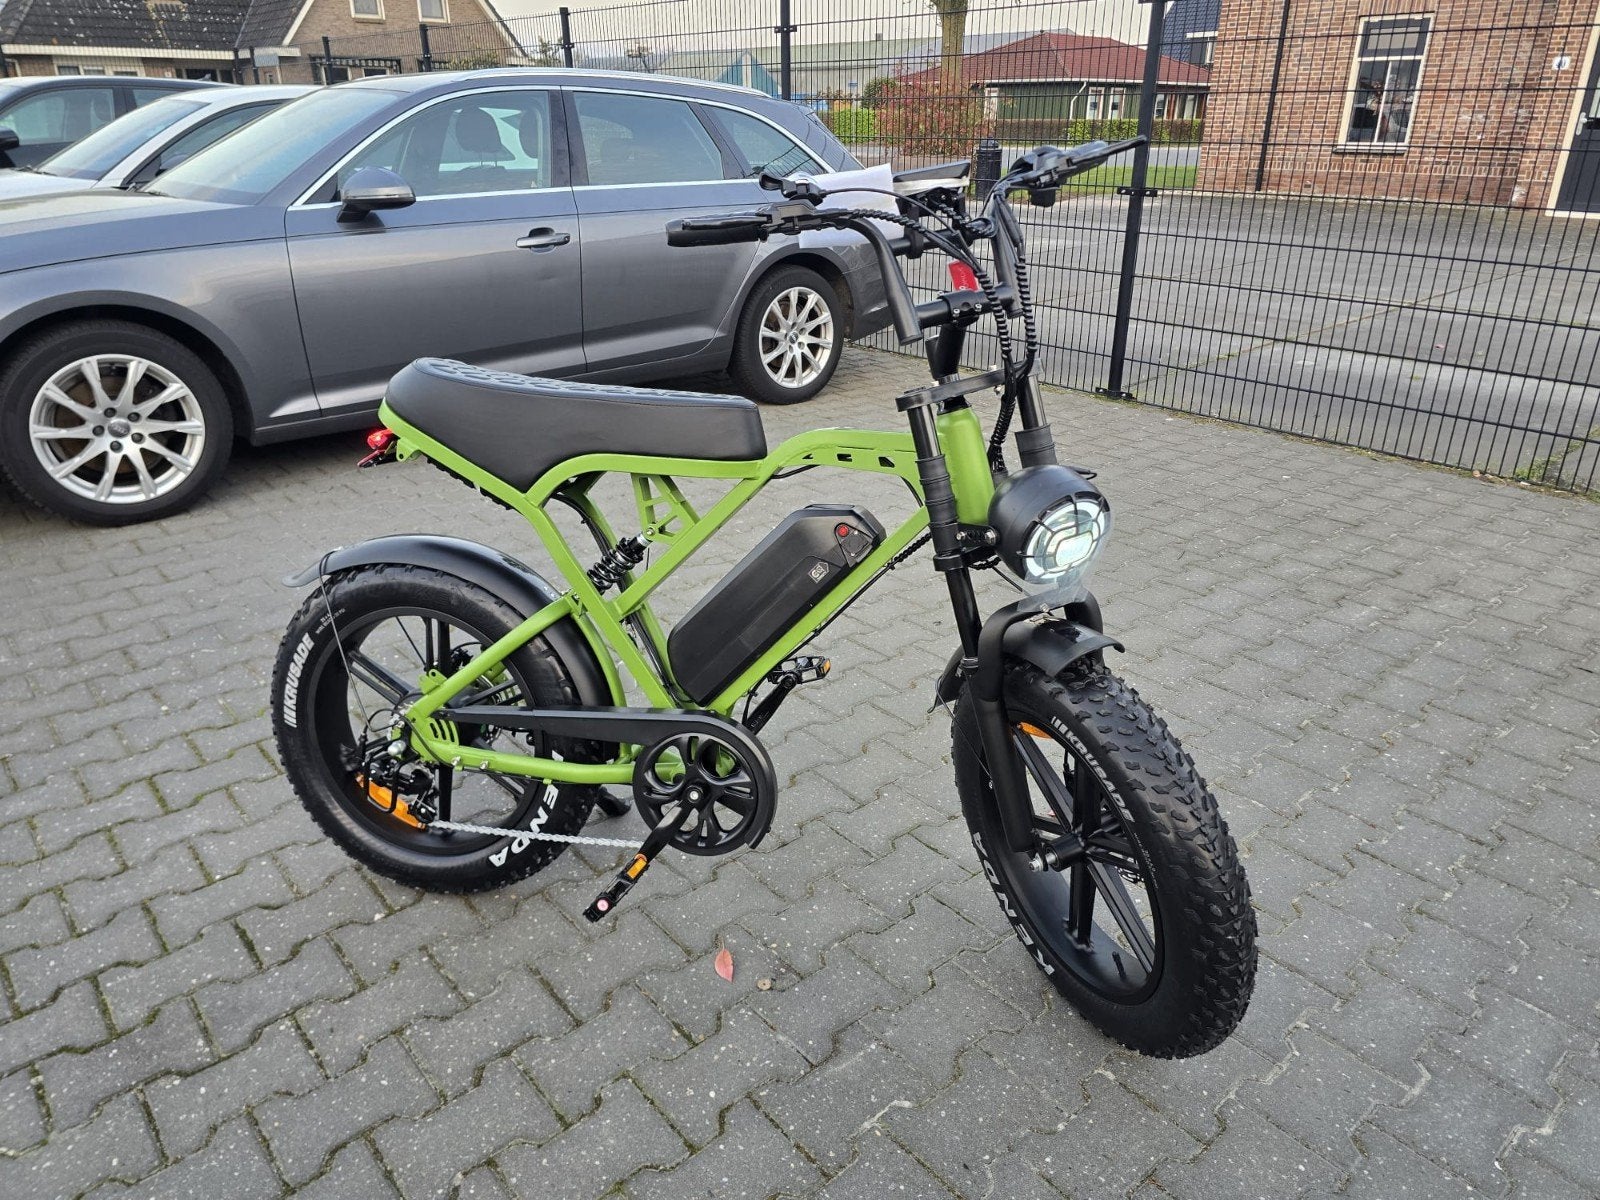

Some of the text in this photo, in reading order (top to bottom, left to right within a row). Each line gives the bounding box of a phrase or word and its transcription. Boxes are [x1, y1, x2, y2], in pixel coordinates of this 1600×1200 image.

[283, 632, 315, 707] KRUSADE
[488, 749, 564, 868] ENDA
[1065, 730, 1135, 823] KRUSADE
